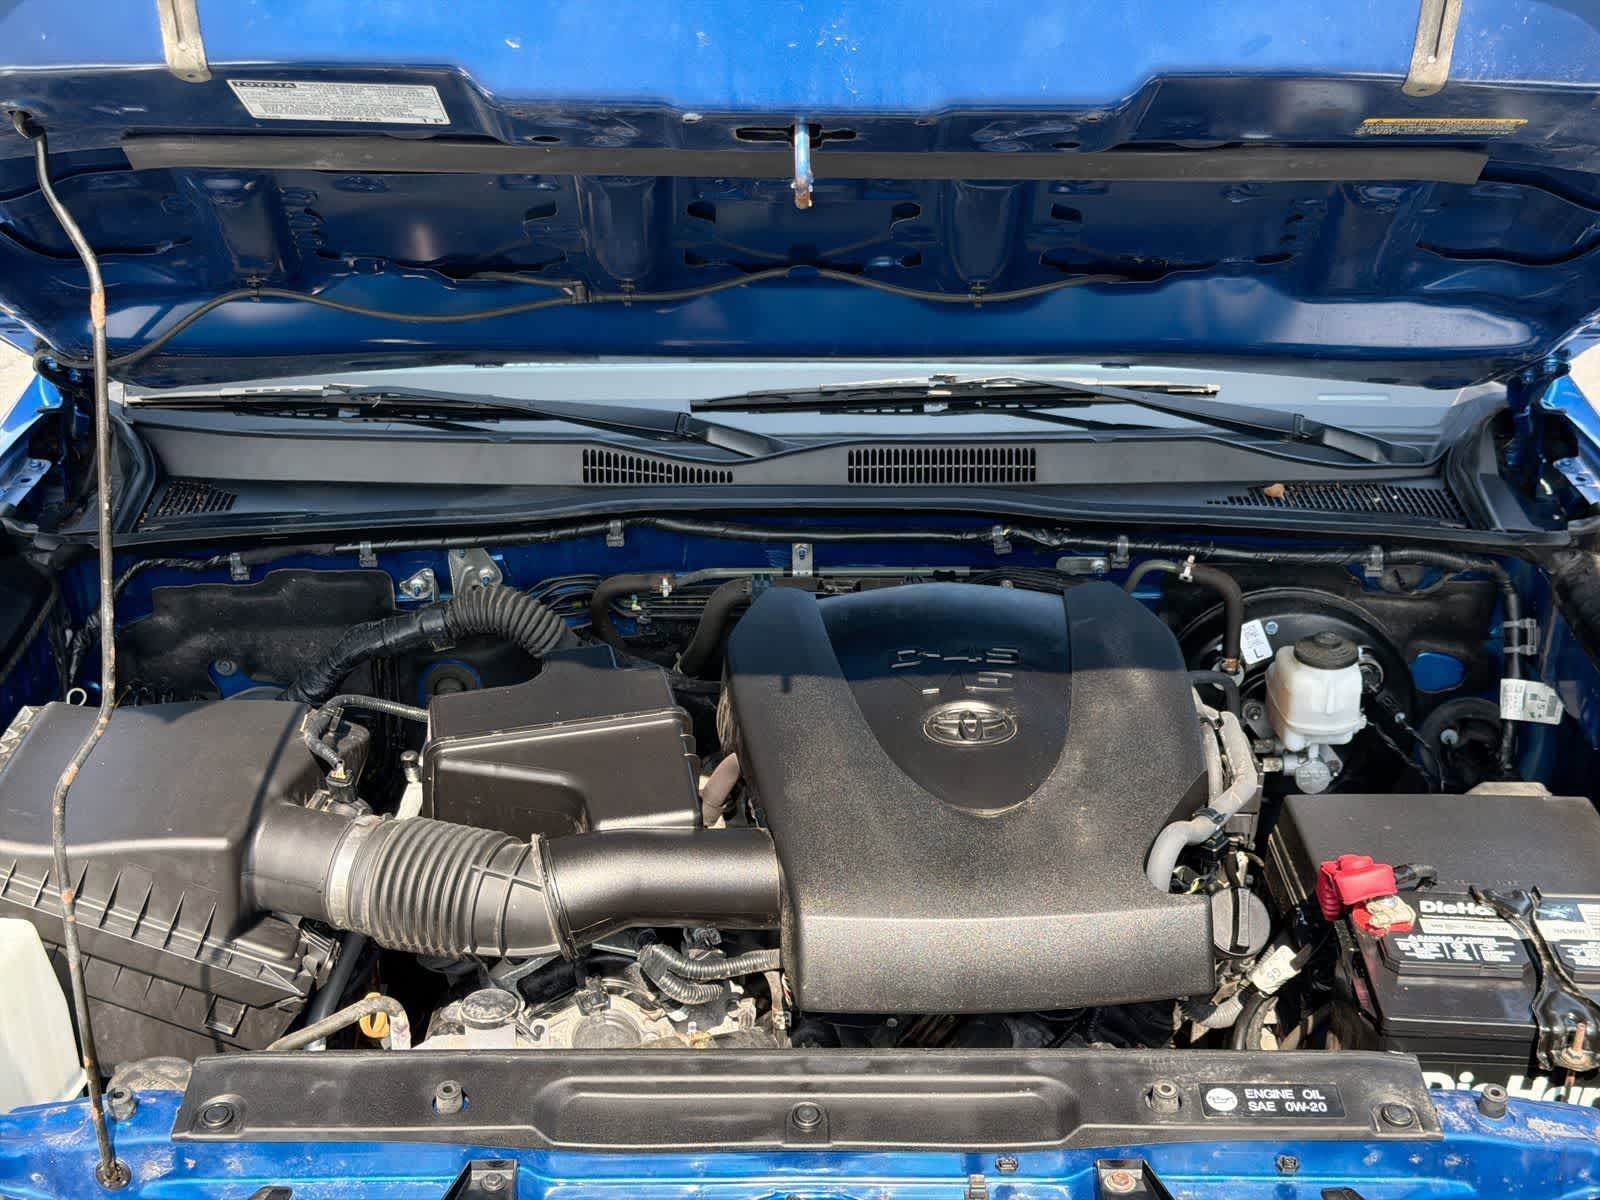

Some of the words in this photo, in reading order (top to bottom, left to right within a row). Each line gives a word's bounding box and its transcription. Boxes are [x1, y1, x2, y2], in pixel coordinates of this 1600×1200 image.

[231, 81, 297, 89] TOYOTA
[1419, 900, 1497, 916] DieHa
[1244, 1088, 1295, 1100] ENGINE
[1302, 1089, 1326, 1100] OIL
[1248, 1101, 1277, 1112] SAE
[1285, 1102, 1328, 1113] 0W-20
